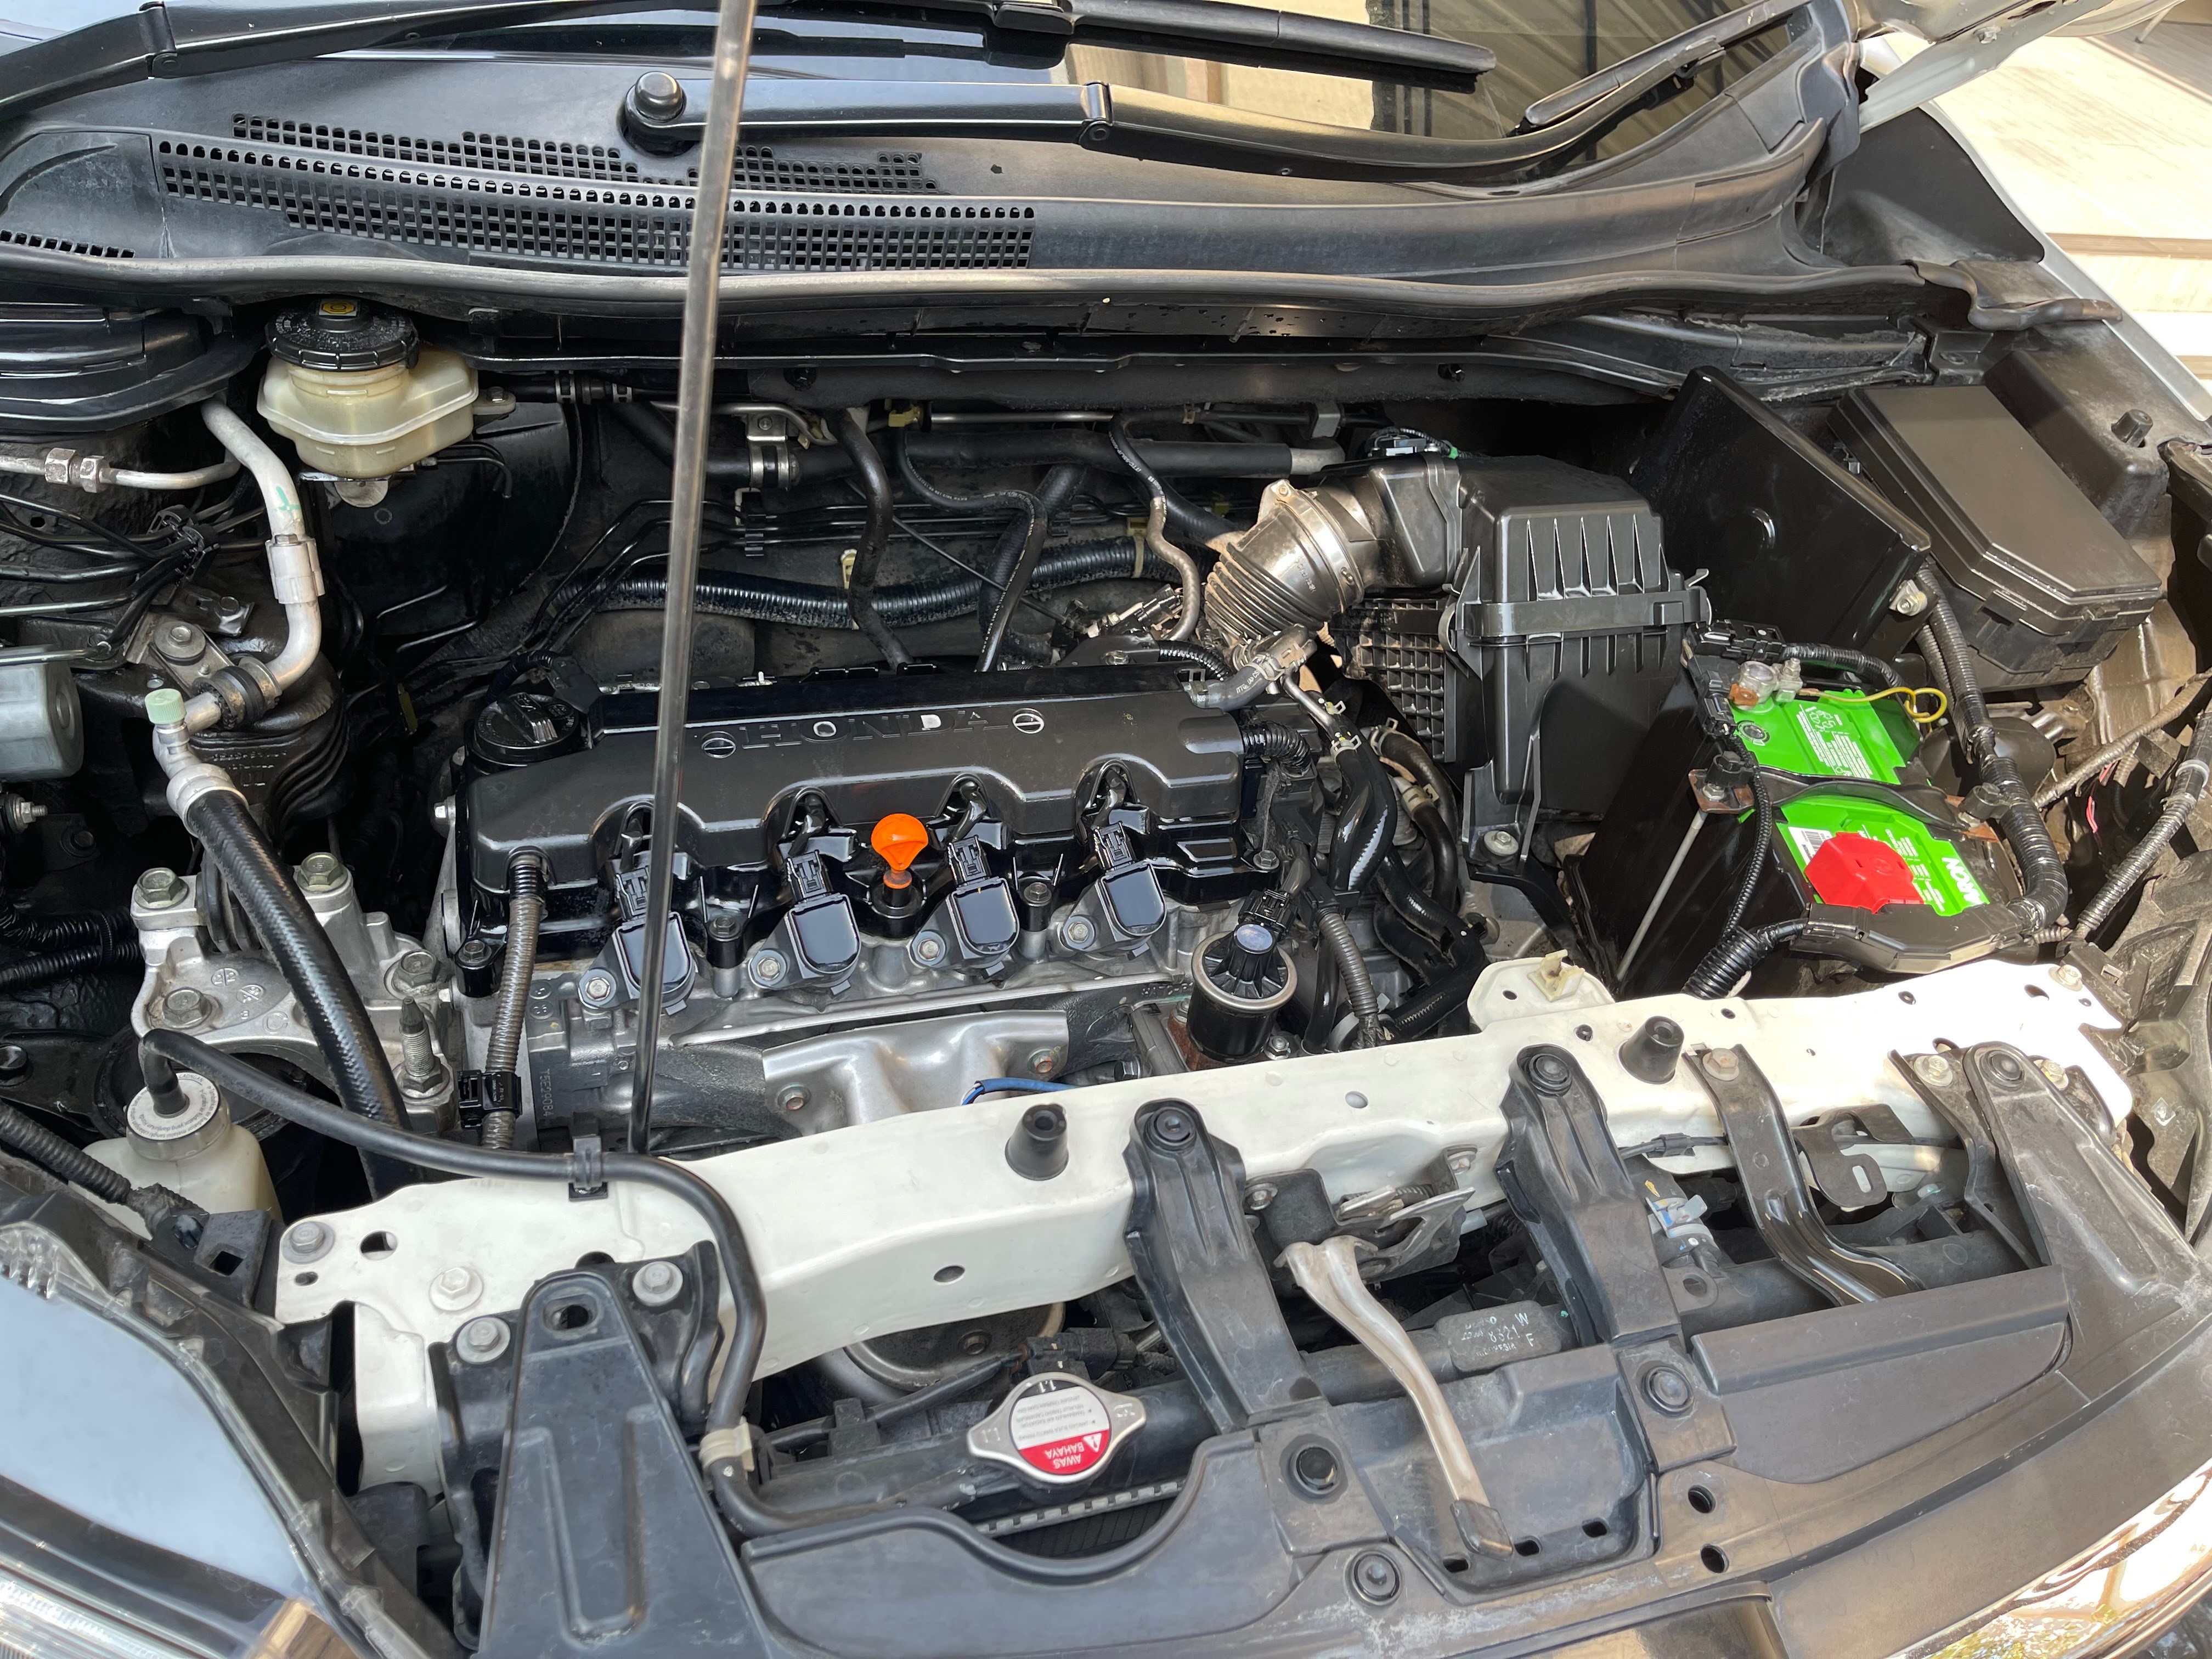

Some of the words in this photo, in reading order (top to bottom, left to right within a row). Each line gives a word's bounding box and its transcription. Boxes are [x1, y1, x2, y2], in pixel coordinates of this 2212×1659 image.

[739, 709, 1009, 749] HONDA
[1044, 1441, 1085, 1460] BAHAYA
[1053, 1454, 1082, 1470] AWAS
